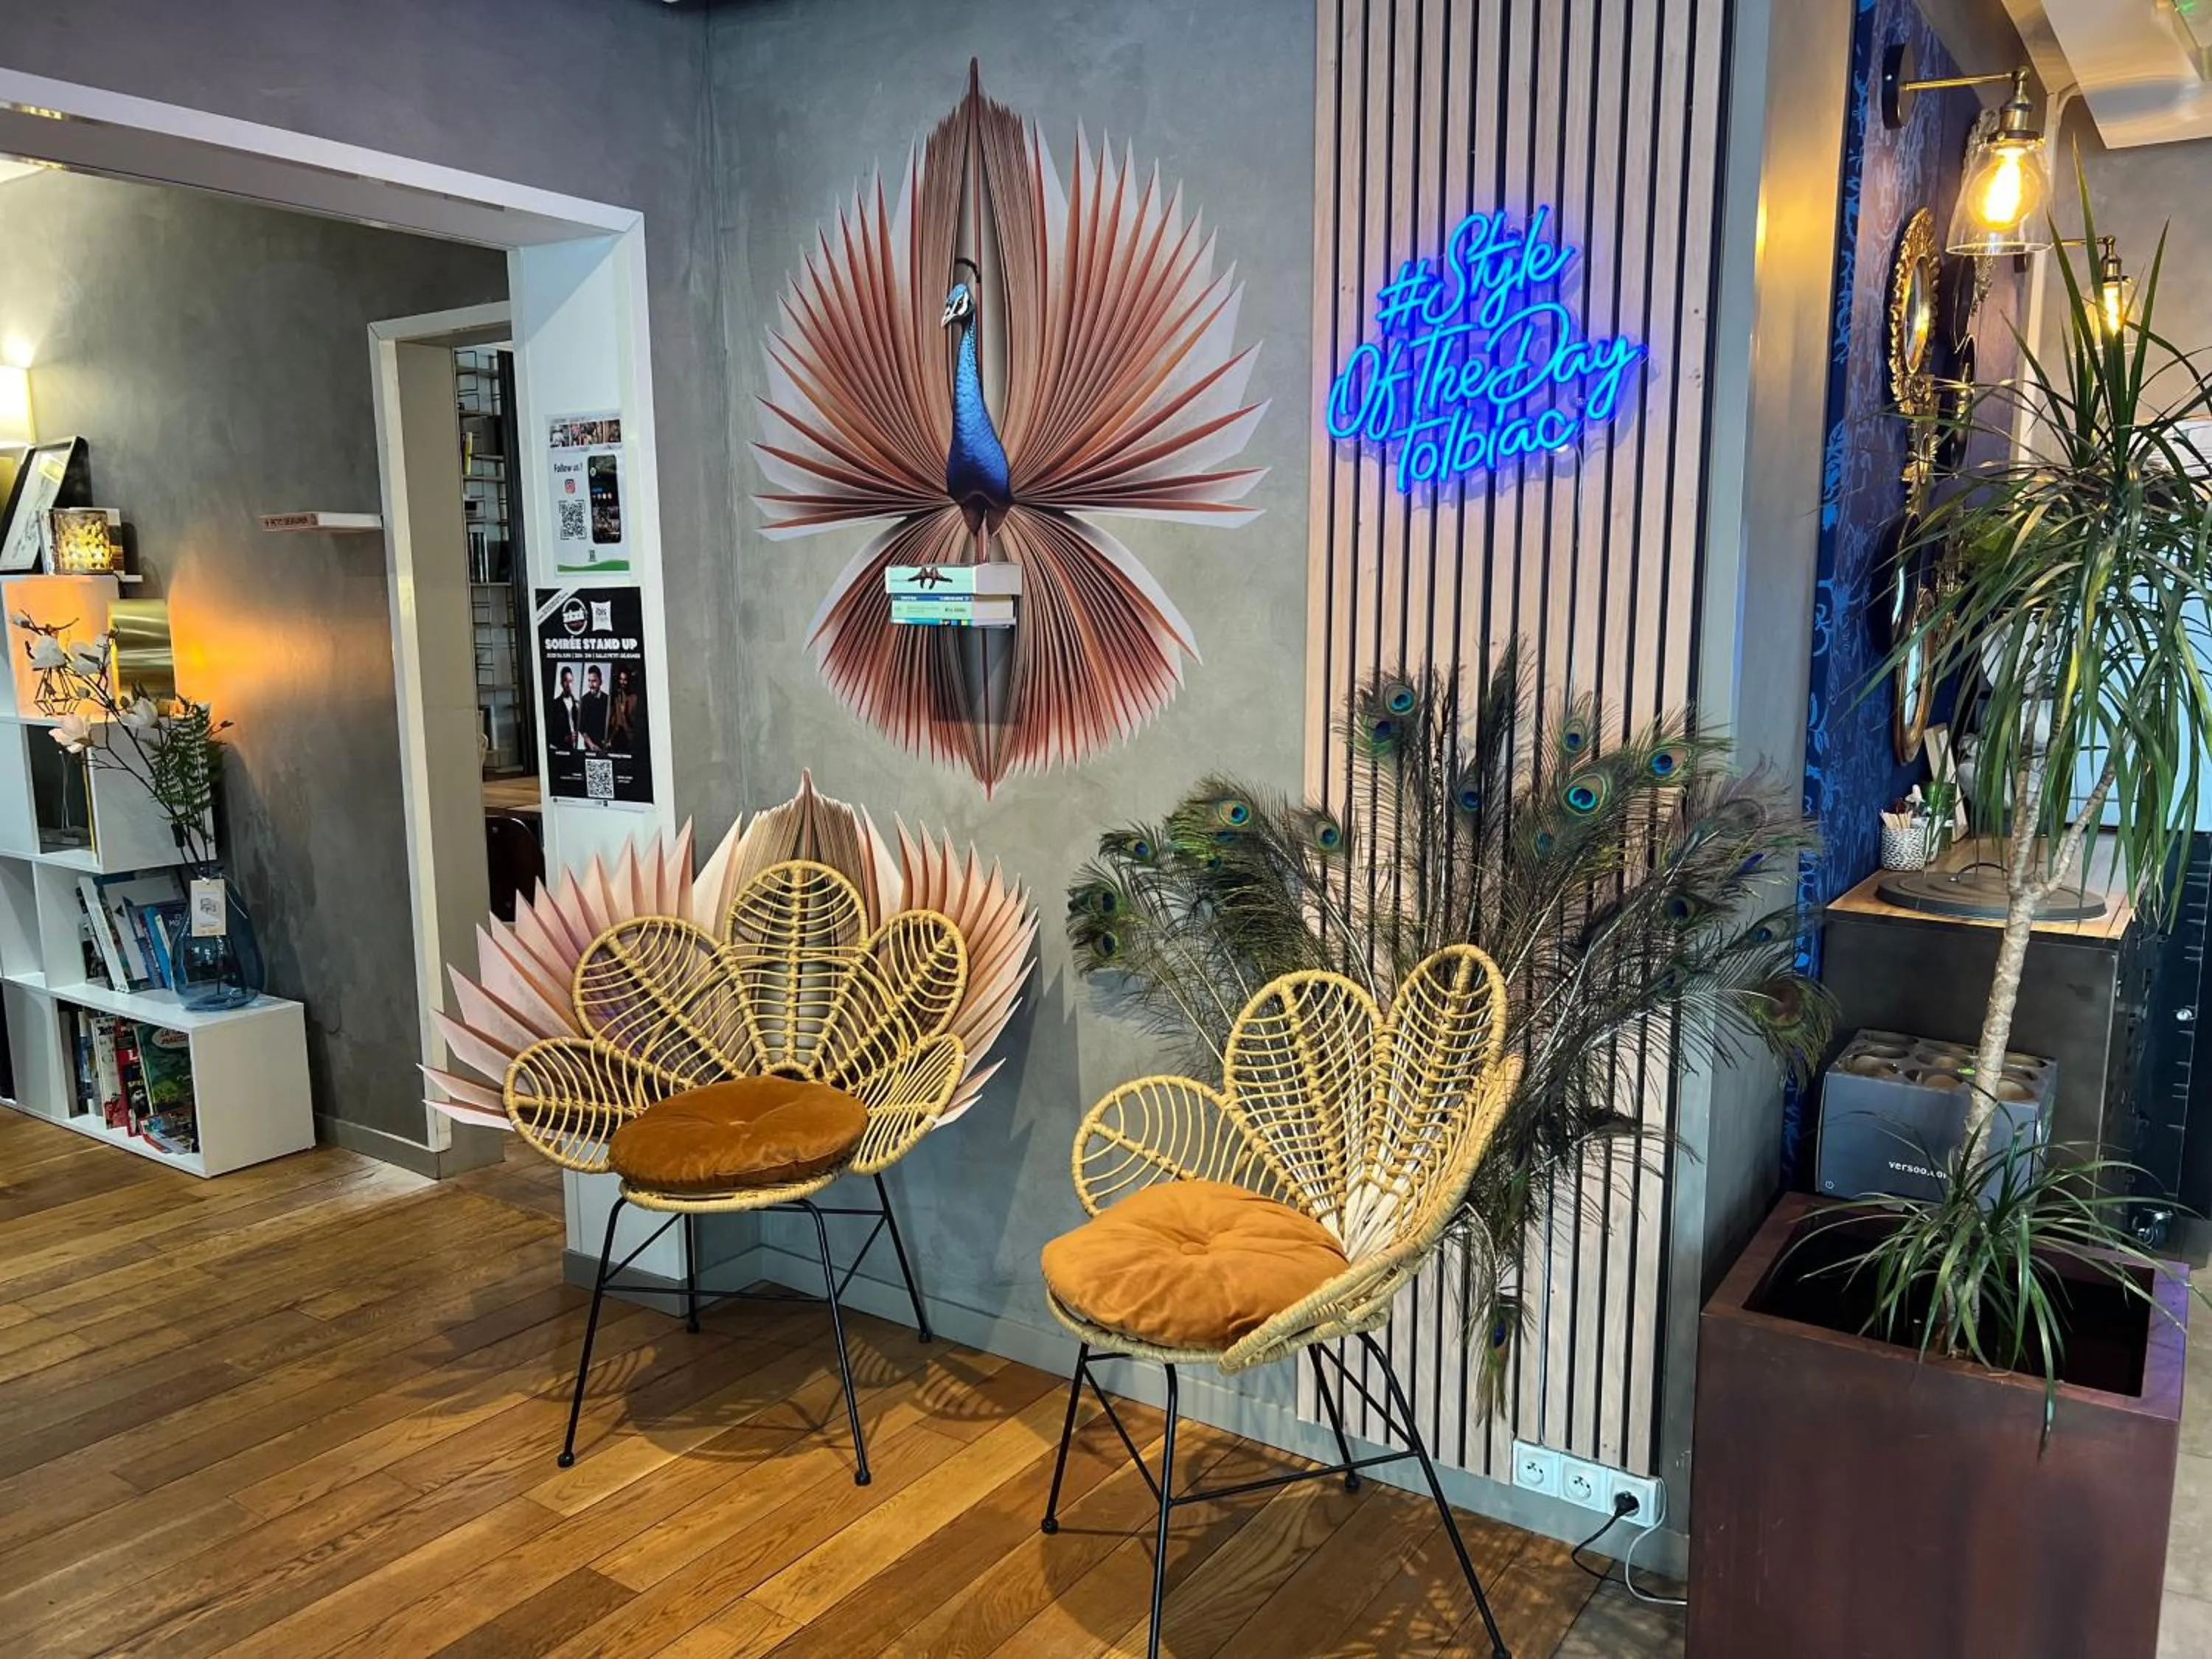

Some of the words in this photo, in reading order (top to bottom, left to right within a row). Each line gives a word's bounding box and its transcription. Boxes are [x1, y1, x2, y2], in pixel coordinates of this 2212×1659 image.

[1377, 204, 1576, 335] #Style
[545, 635, 582, 650] SOIRÉE
[582, 637, 620, 650] STAND
[621, 637, 638, 650] UP
